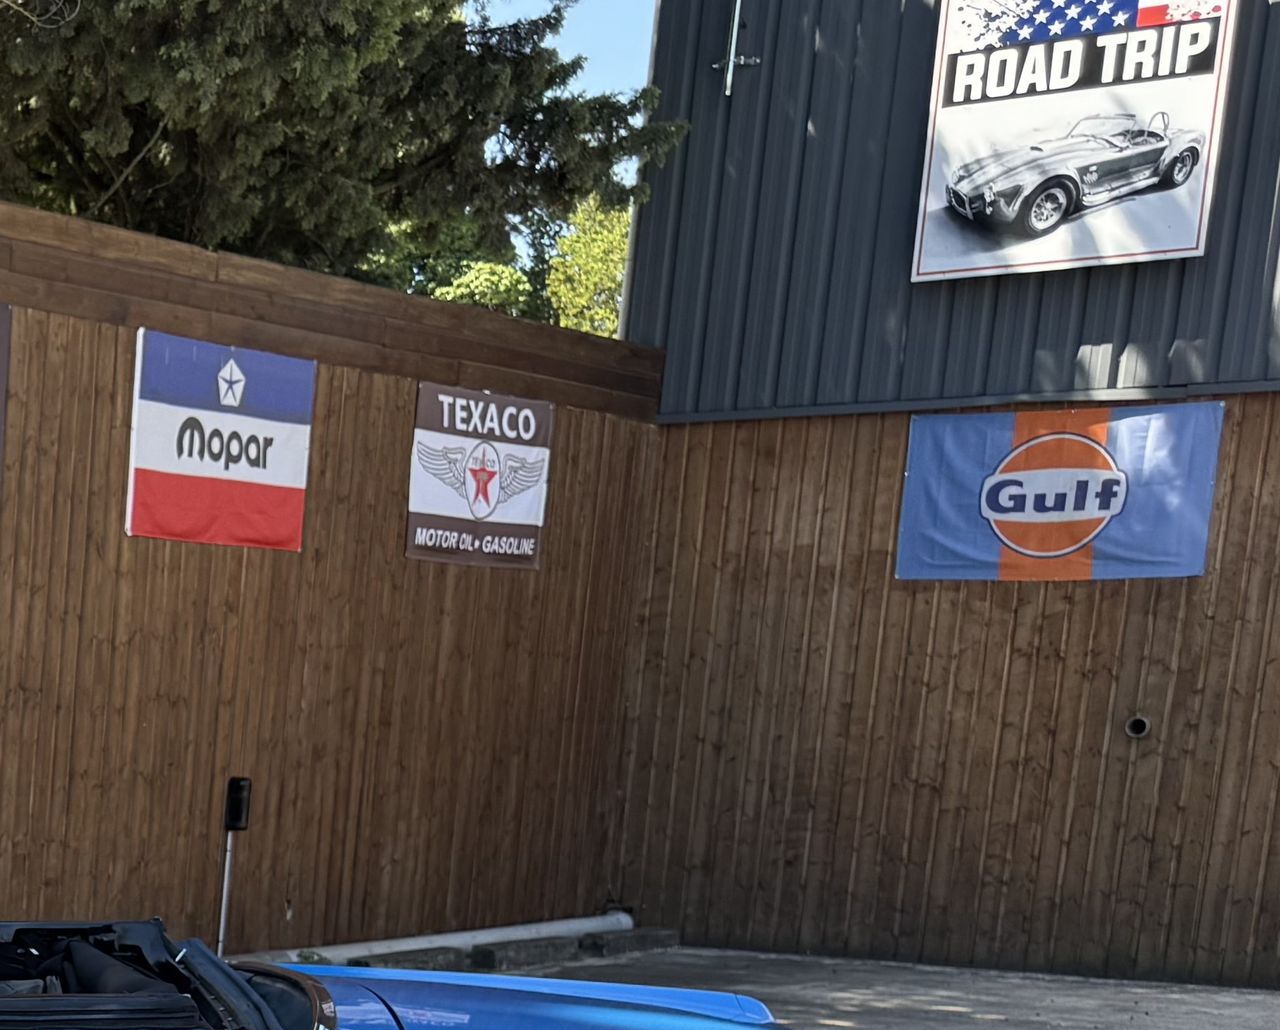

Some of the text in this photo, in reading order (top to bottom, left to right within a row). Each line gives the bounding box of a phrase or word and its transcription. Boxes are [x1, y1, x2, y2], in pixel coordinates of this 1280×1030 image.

[952, 22, 1211, 103] ROAD TRIP
[437, 394, 536, 441] TEXACO
[176, 416, 274, 471] Mopar
[985, 478, 1121, 513] Gulf
[414, 527, 536, 556] MOTOR OIL GASOLINE
